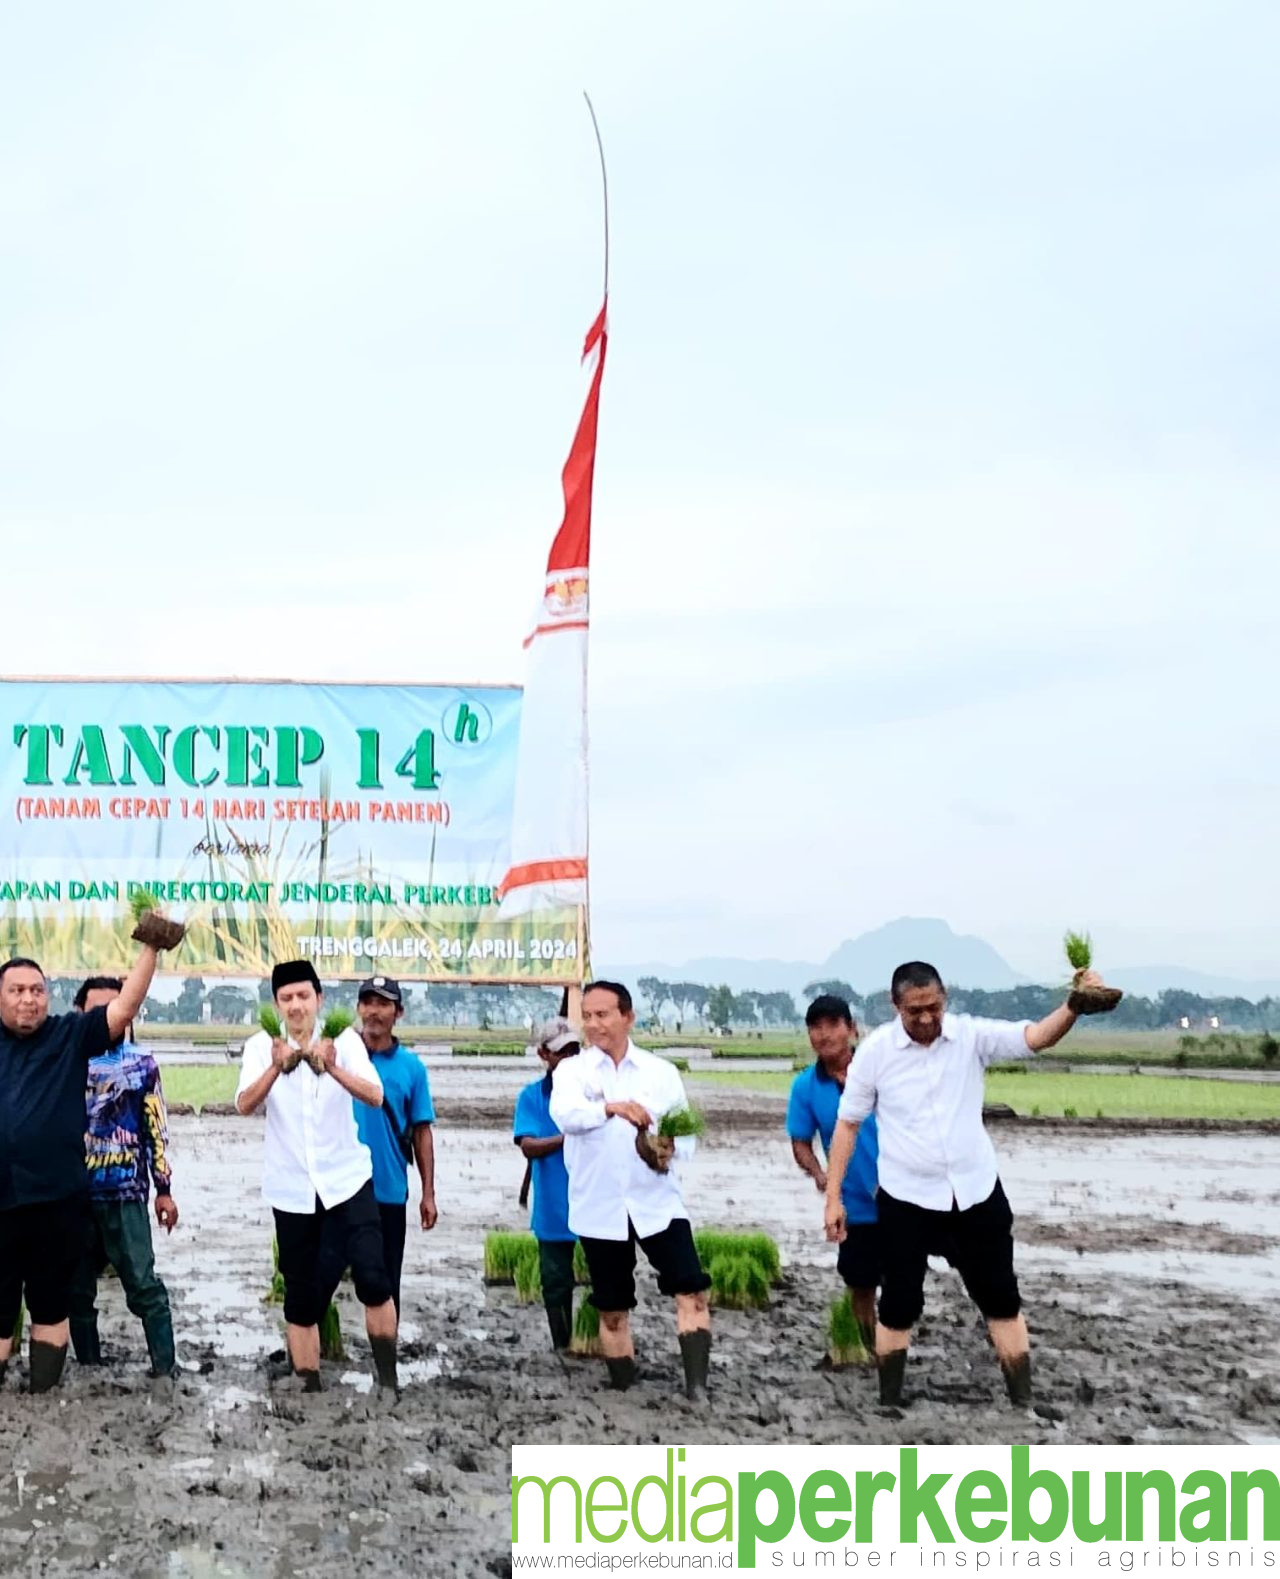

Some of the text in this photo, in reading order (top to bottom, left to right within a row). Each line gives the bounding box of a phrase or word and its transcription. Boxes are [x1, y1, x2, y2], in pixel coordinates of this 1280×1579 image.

[14, 703, 479, 790] TANCEP 14 h
[16, 796, 451, 828] (TANAM CEPAT 14 HARI SETELAH PANEN)
[69, 881, 120, 902] DAN
[127, 881, 272, 903] DIREKTORAT
[280, 882, 397, 905] JENDERAL
[297, 935, 577, 960] TRENGGALEK, 24 APRIL 2024
